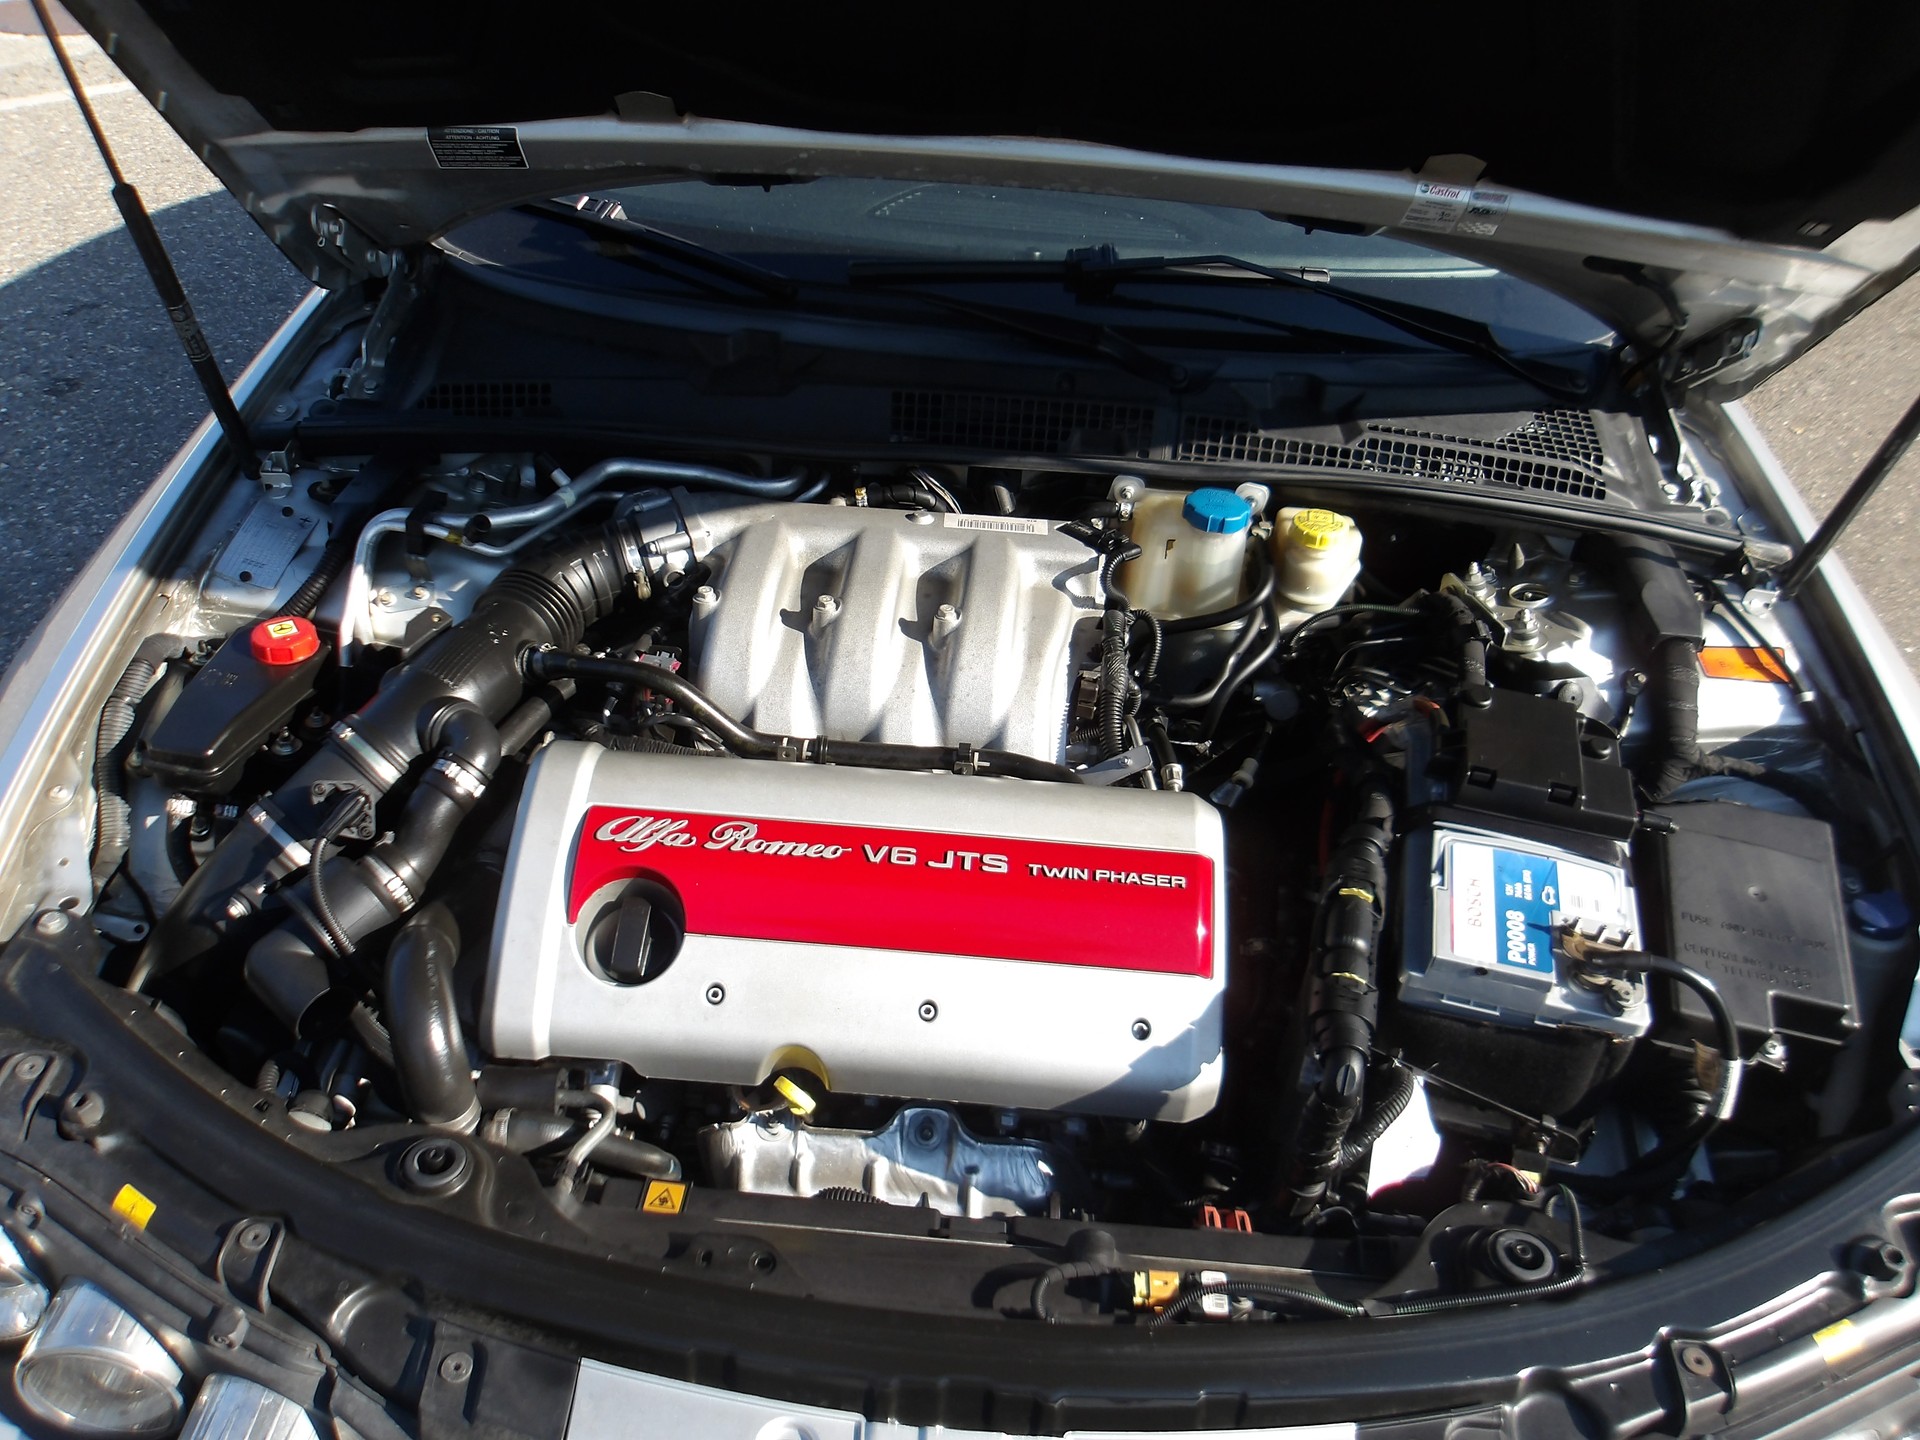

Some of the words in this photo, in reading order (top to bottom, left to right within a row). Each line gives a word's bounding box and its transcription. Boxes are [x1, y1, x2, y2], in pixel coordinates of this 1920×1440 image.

[1430, 185, 1461, 199] Castrol
[595, 815, 697, 852] Alfa
[703, 820, 852, 859] Romeo
[863, 844, 917, 866] V6
[927, 850, 1008, 874] JTS
[1027, 863, 1089, 882] TWIN
[1094, 869, 1186, 889] PHASER
[1467, 879, 1482, 927] BOSCH
[1681, 911, 1712, 926] FUSE
[1505, 909, 1527, 964] P0008
